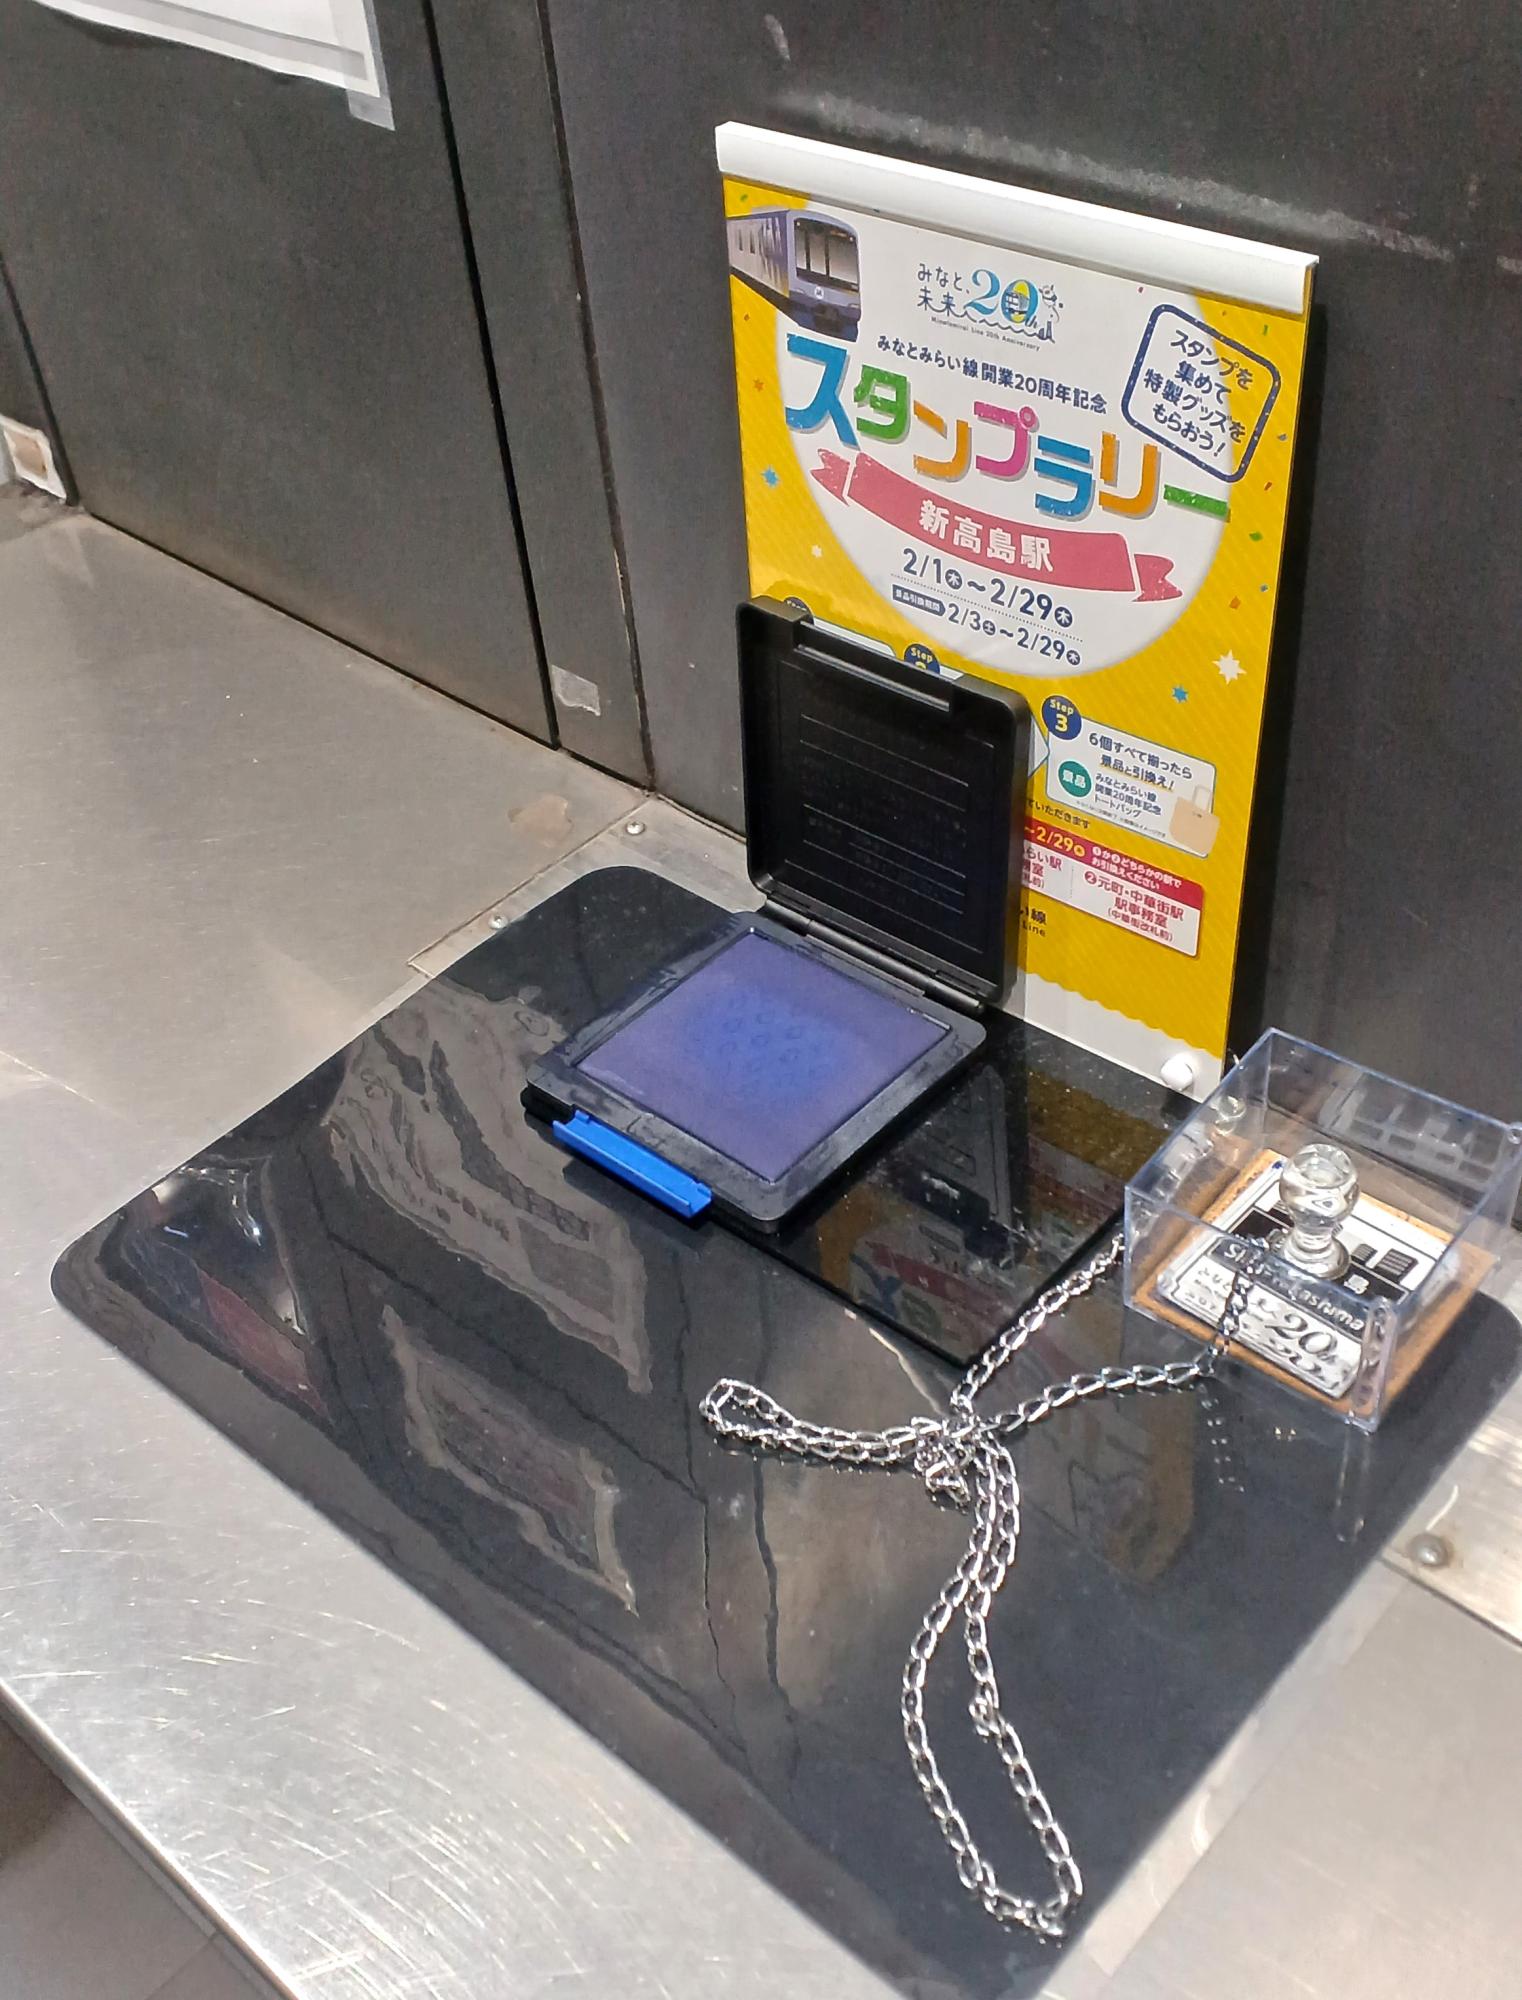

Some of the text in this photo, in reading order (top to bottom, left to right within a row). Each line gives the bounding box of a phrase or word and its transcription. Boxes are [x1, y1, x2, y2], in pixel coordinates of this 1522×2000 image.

[876, 335, 1108, 415] みなとみらい線開業20周年記念
[1169, 329, 1254, 391] スタンプを
[1174, 360, 1232, 405] 集めて
[785, 333, 1229, 521] スタンプラリー
[1143, 367, 1247, 444] 特製グッズを
[1152, 403, 1227, 458] もらおう！
[918, 499, 1055, 573] 新高島駅
[910, 646, 934, 664] Step
[1049, 699, 1074, 717] Step
[1054, 713, 1069, 733] 3
[1088, 731, 1193, 780] 6個すべて揃ったら
[1094, 794, 1142, 818] トートバッグ
[1095, 772, 1158, 803] みなとみらい線
